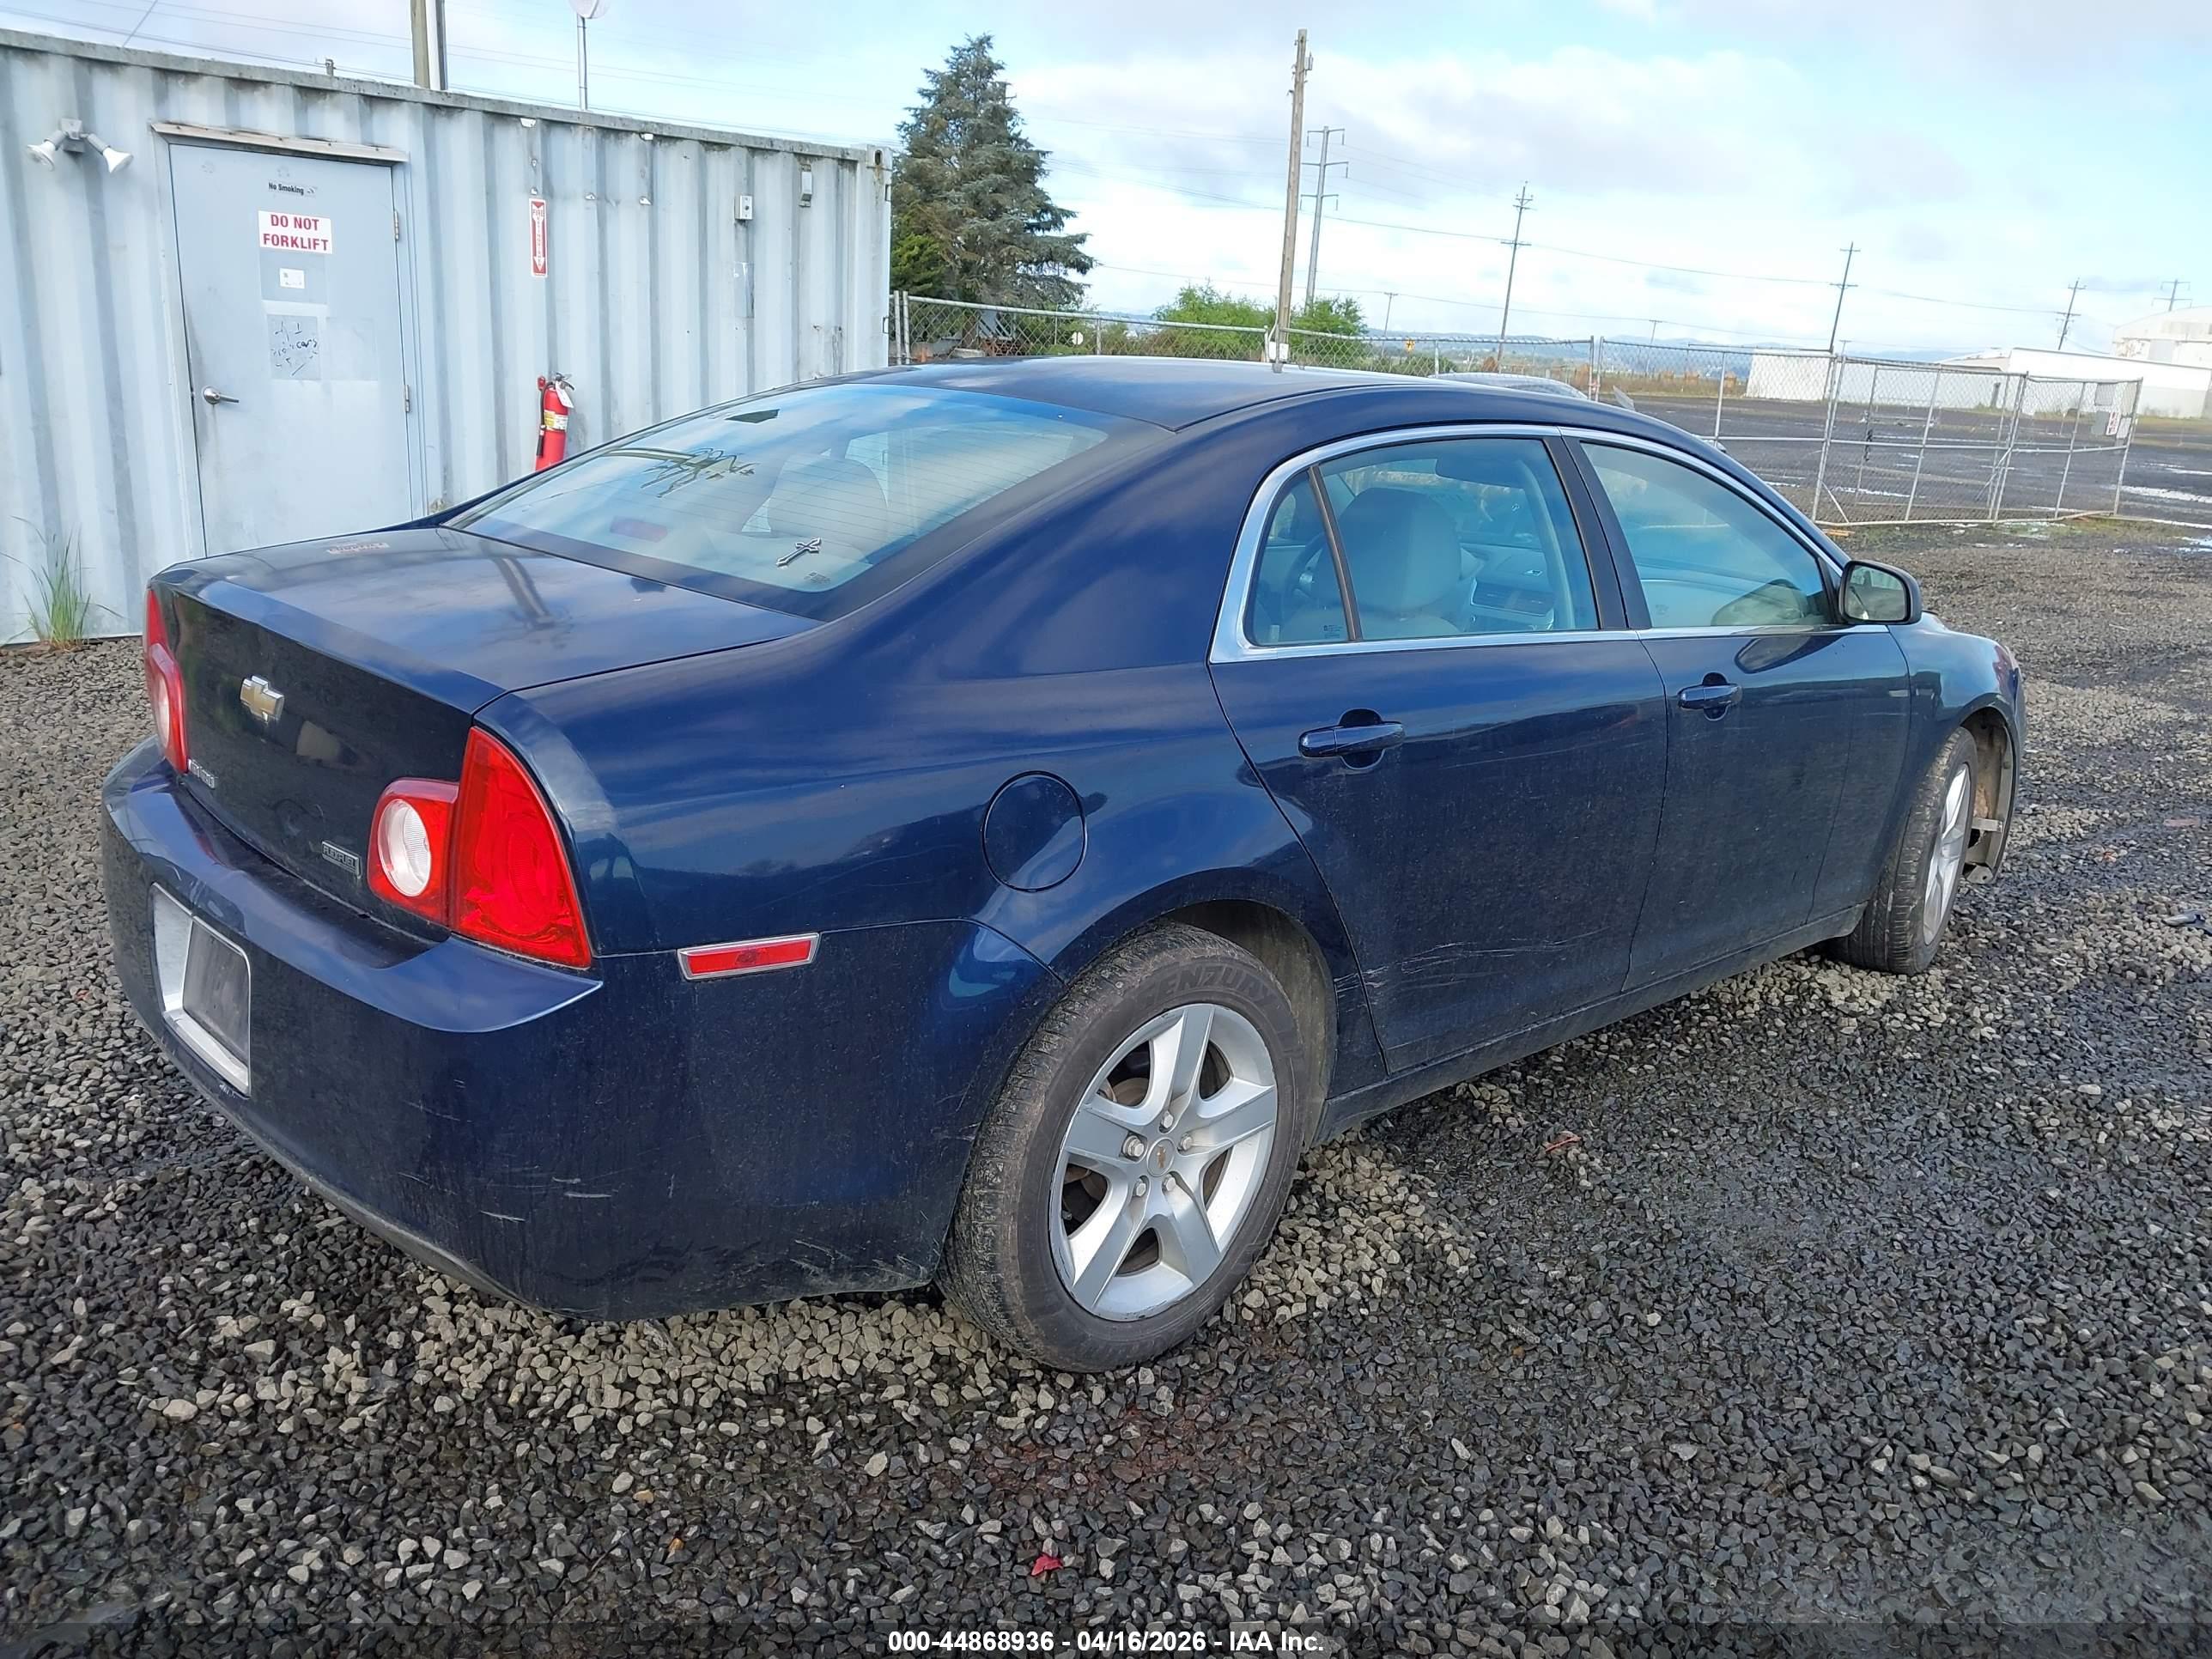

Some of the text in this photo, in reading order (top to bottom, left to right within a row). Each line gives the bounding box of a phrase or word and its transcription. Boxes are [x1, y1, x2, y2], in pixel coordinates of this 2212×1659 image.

[268, 182, 304, 196] No Smoking
[532, 209, 544, 217] FIRE
[270, 214, 319, 231] DO NOT
[263, 233, 329, 251] FORKLIFT
[323, 845, 356, 870] FLEXFUEL
